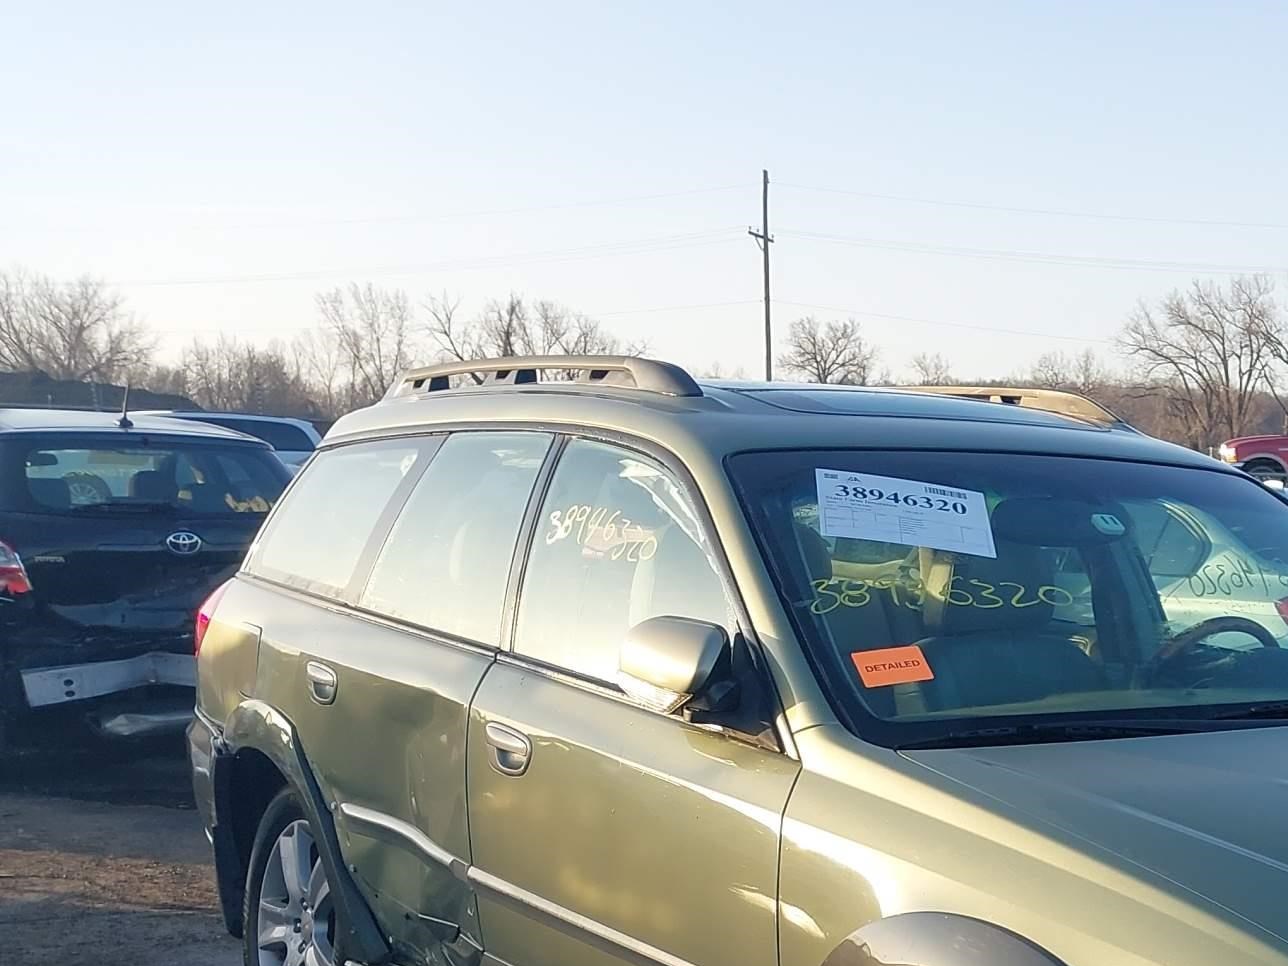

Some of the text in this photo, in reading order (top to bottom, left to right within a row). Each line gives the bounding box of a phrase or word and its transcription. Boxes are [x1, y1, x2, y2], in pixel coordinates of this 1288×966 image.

[834, 484, 968, 515] 38946320
[546, 505, 658, 562] 38946320
[865, 659, 921, 674] DETAILED
